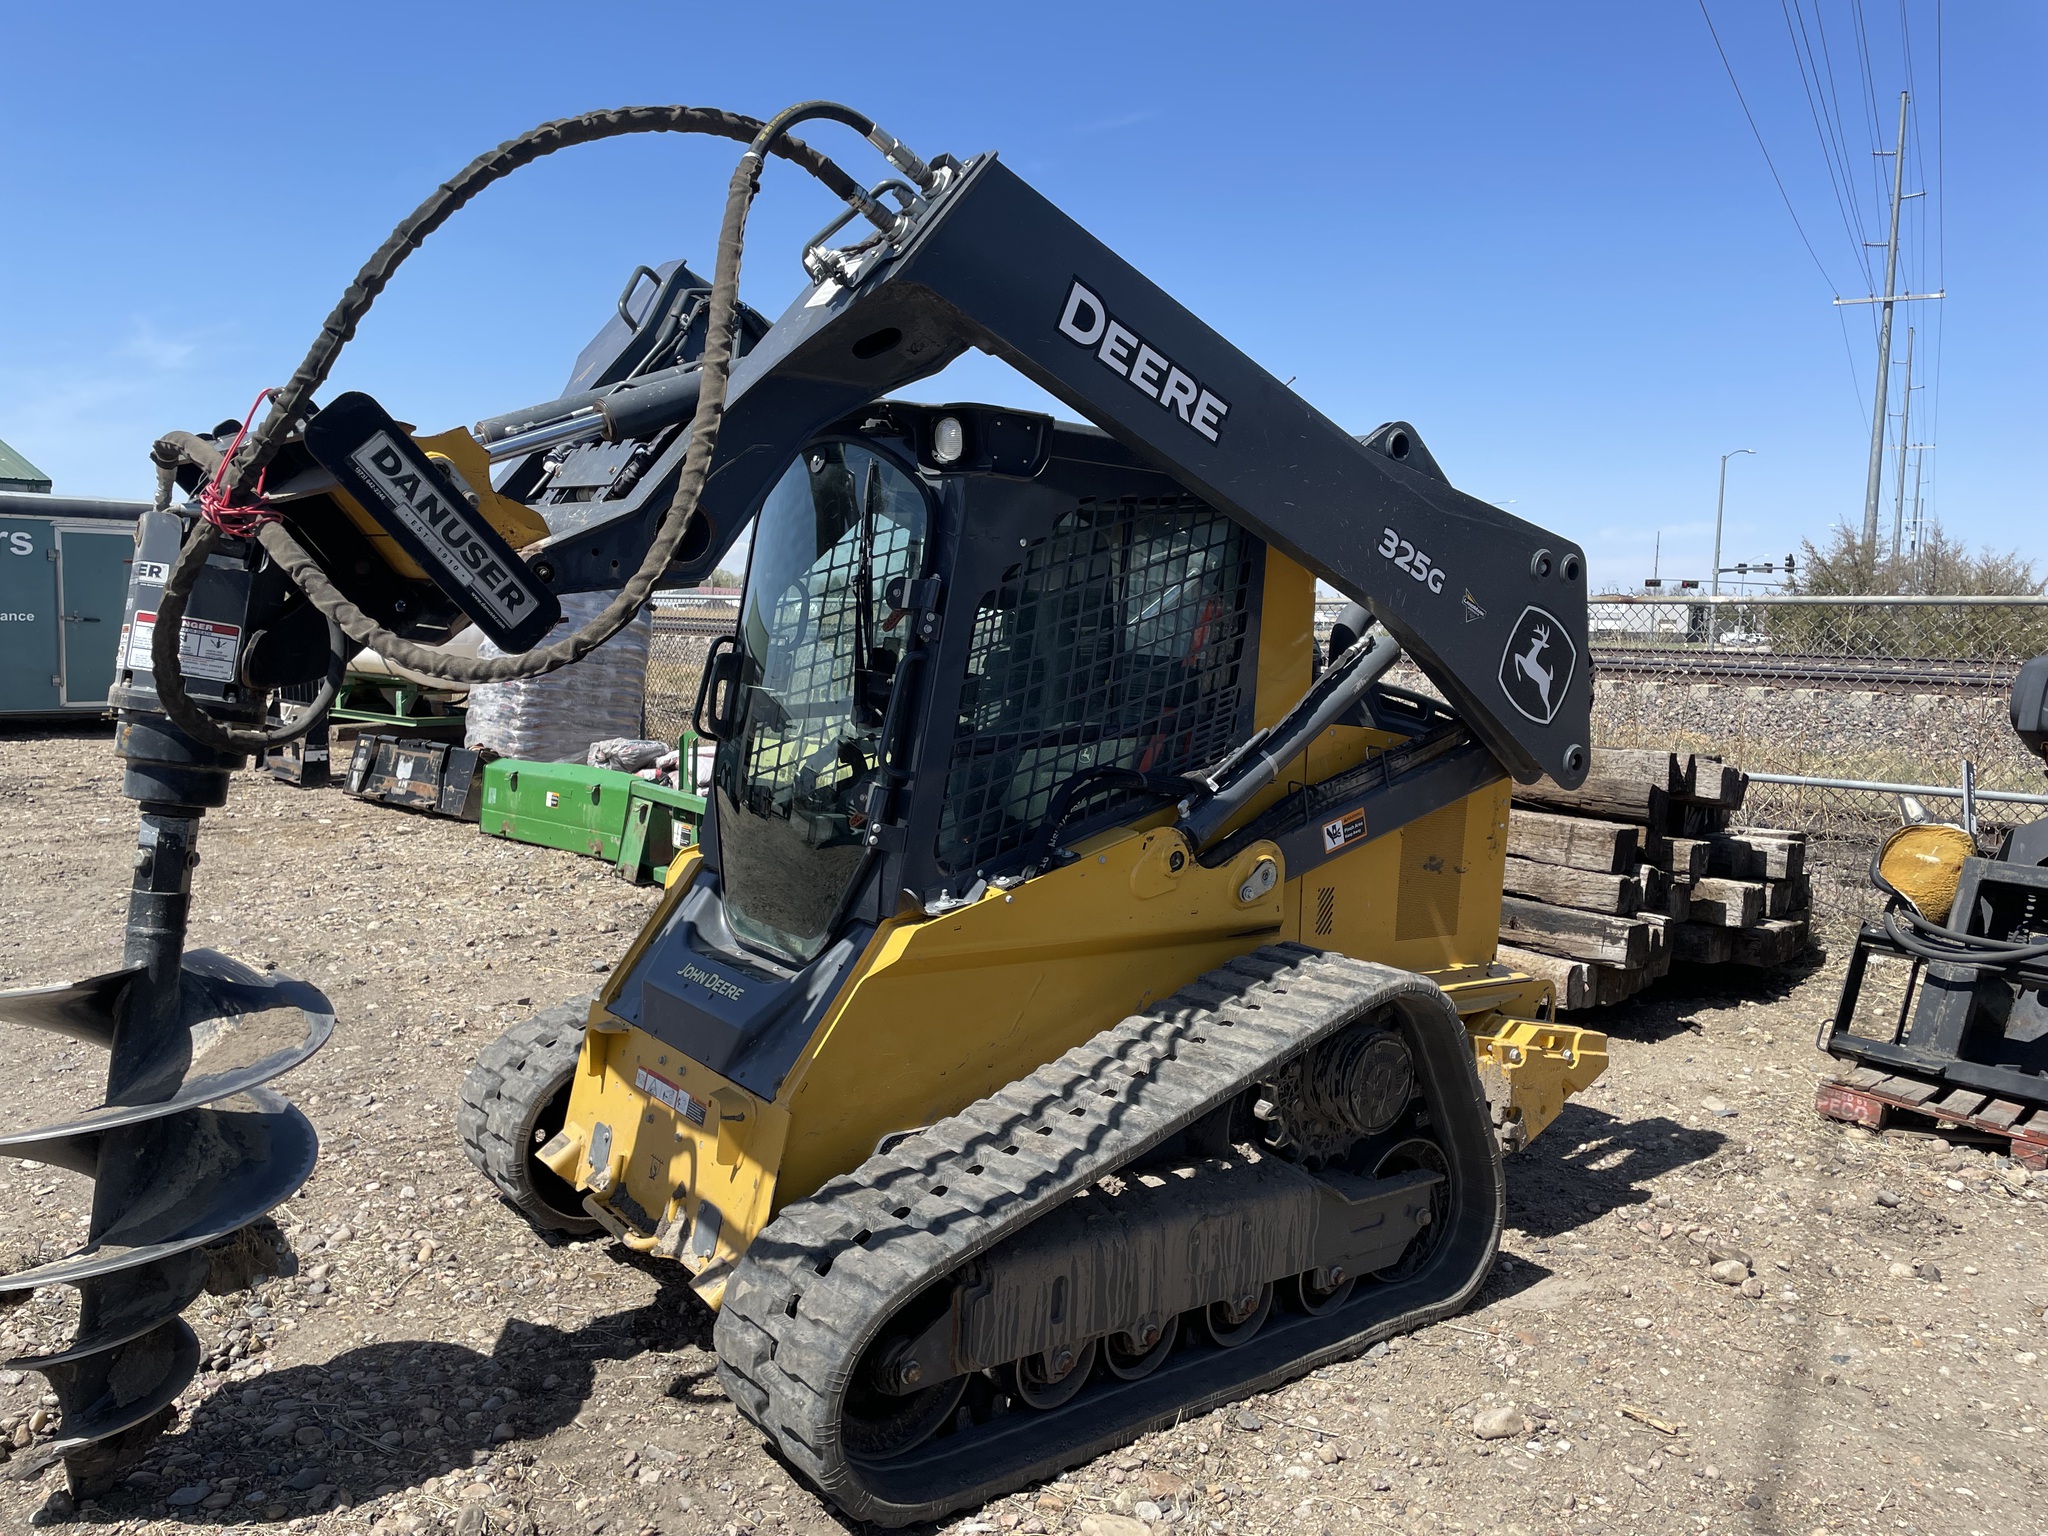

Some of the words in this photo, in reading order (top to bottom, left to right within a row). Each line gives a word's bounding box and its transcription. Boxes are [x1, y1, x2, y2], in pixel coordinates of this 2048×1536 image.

[1058, 281, 1228, 442] DEERE
[370, 443, 526, 615] DANUSER
[437, 546, 460, 572] 1910
[1378, 527, 1446, 595] 325G
[0, 612, 35, 622] ance
[471, 592, 507, 630] www.danuser.com
[1354, 821, 1363, 829] Area
[676, 962, 710, 985] JOHN
[703, 973, 745, 1001] DEERE
